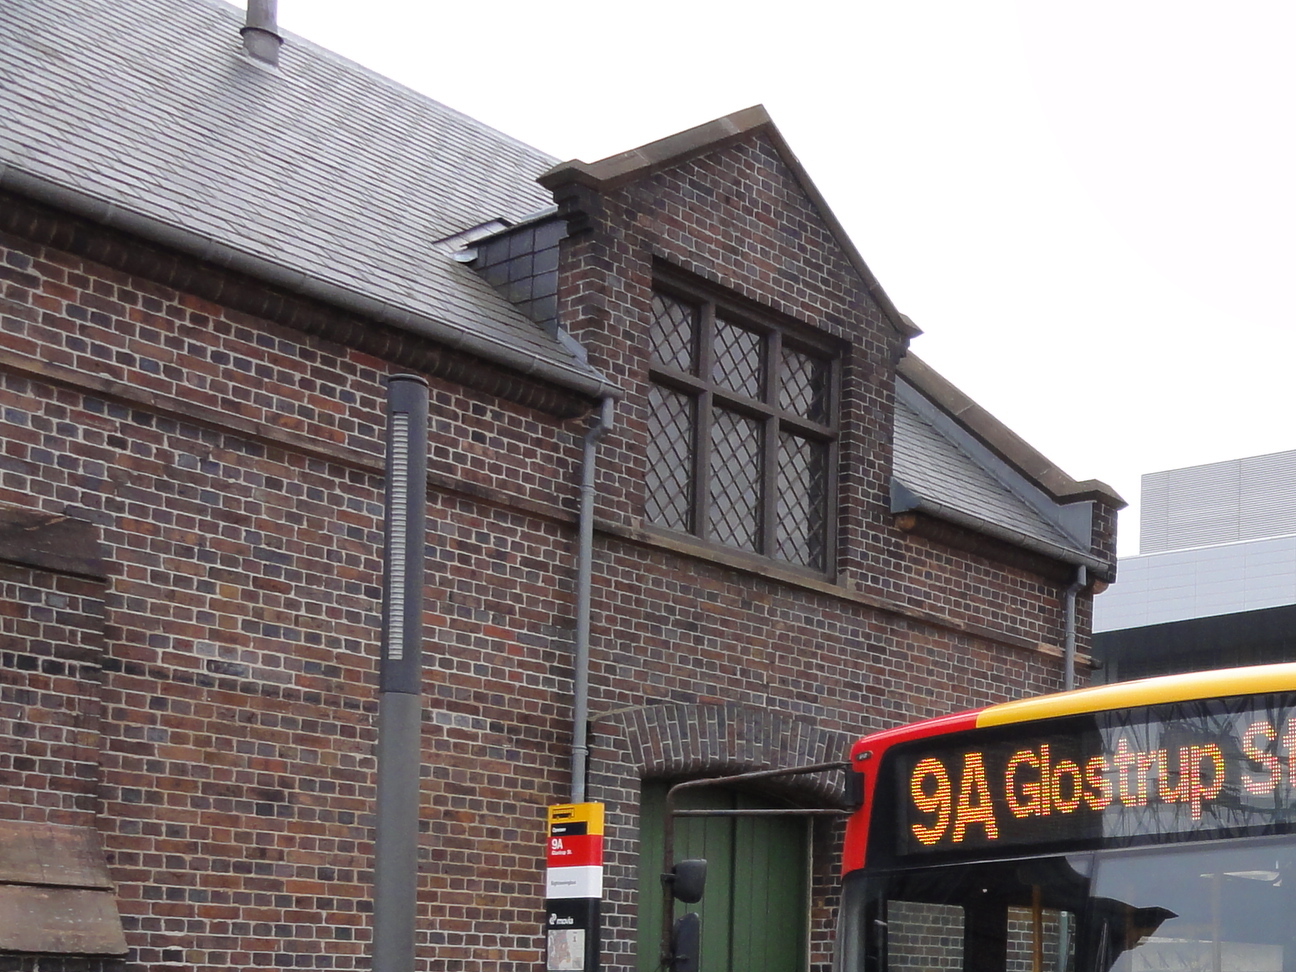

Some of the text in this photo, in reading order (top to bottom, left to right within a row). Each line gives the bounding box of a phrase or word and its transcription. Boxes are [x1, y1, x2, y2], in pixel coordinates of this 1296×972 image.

[909, 752, 999, 846] 9A
[1005, 738, 1226, 821] Glostrup
[551, 838, 564, 850] 9A
